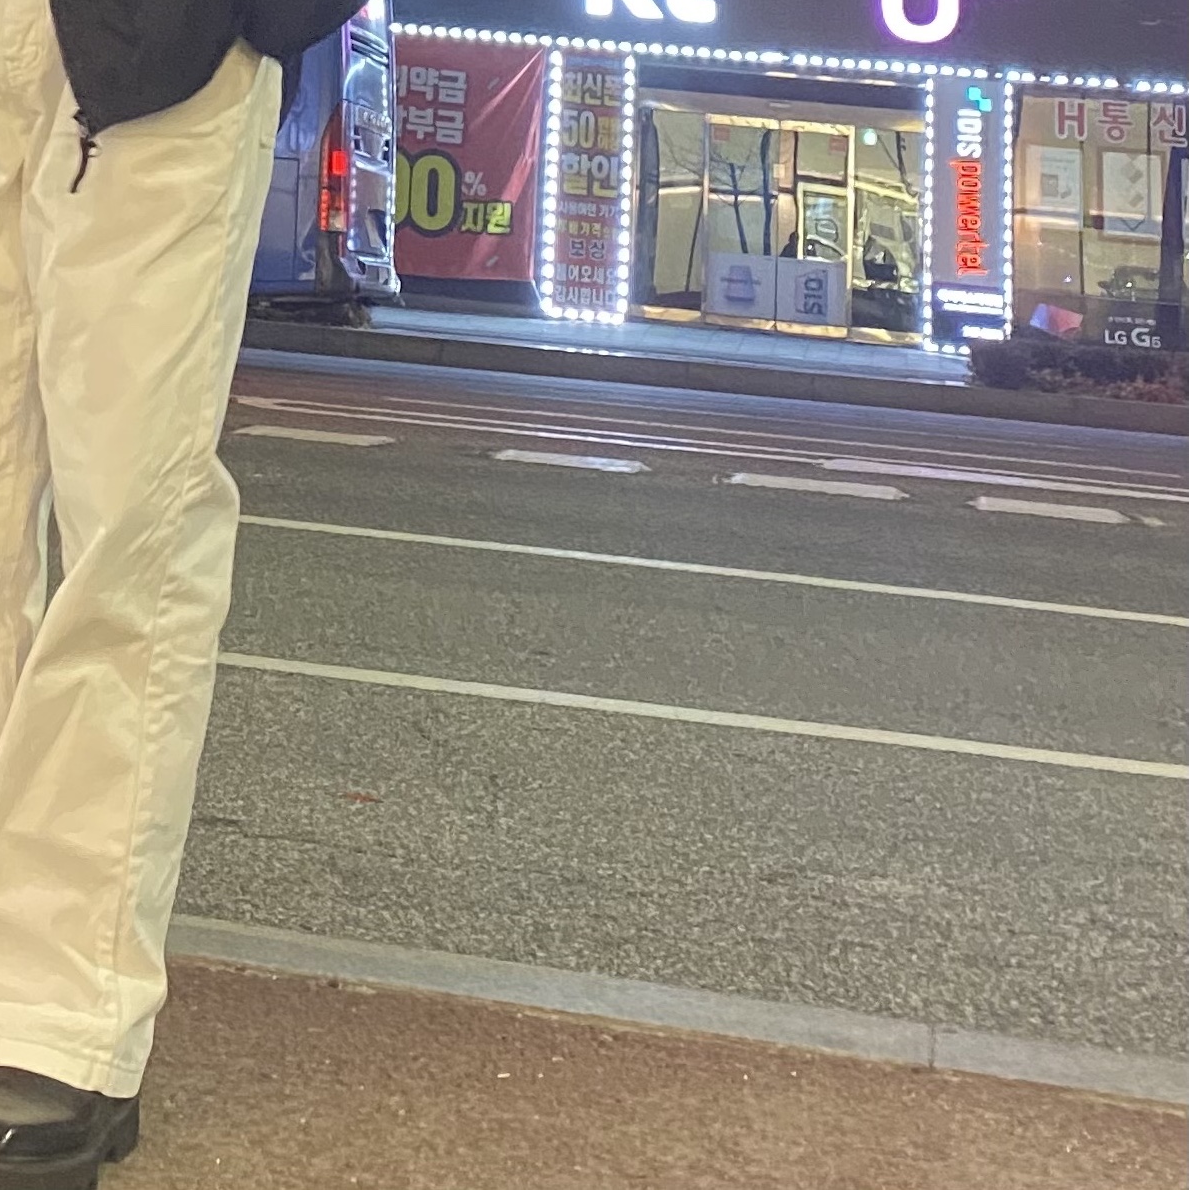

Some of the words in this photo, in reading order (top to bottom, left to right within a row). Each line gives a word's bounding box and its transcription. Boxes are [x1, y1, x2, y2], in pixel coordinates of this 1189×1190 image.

[562, 109, 596, 149] 50
[956, 108, 983, 159] IDIS
[561, 152, 620, 199] 할인
[462, 201, 512, 235] 지원
[948, 159, 990, 277] powertel
[569, 237, 606, 262] 보상
[554, 285, 617, 307] 감사합니다
[1104, 328, 1128, 346] LG
